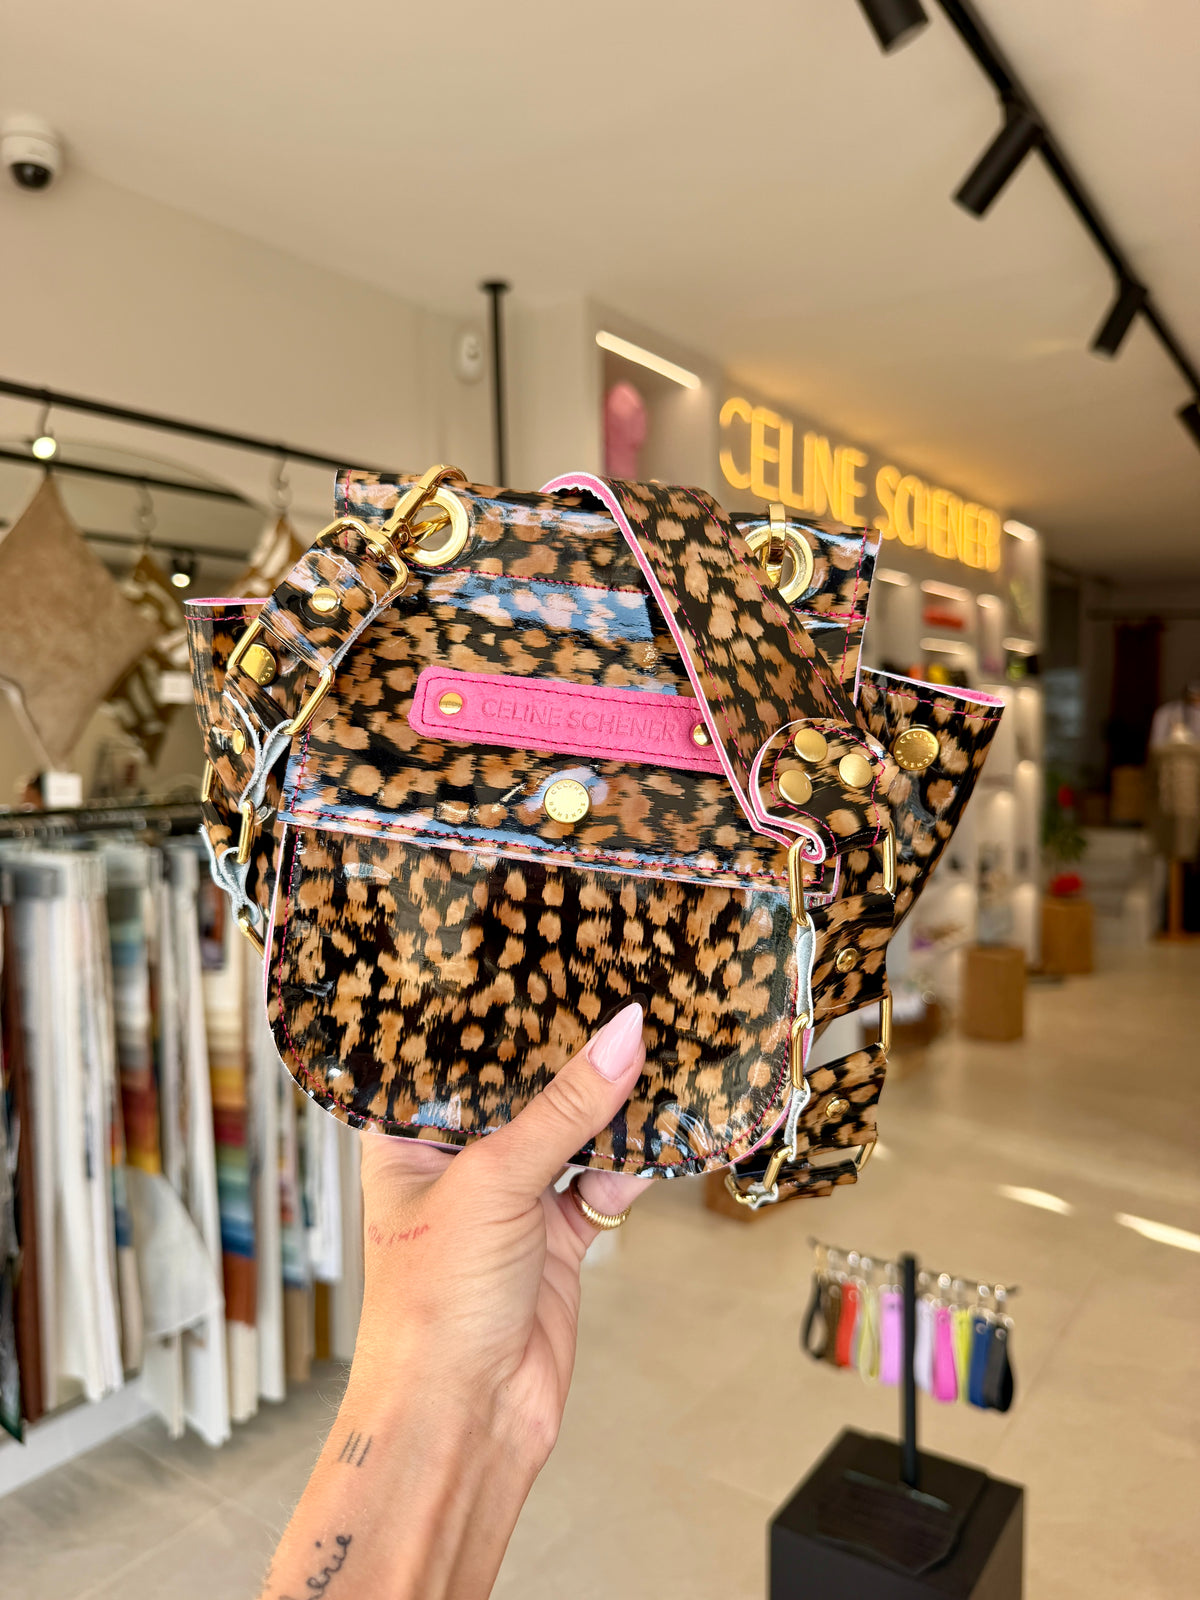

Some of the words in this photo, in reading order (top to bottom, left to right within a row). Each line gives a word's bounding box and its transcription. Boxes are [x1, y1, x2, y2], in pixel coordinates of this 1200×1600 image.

[719, 397, 868, 527] CELINE
[872, 465, 1001, 573] SCHENER
[481, 701, 563, 728] CELINE
[567, 710, 677, 742] SCHENER
